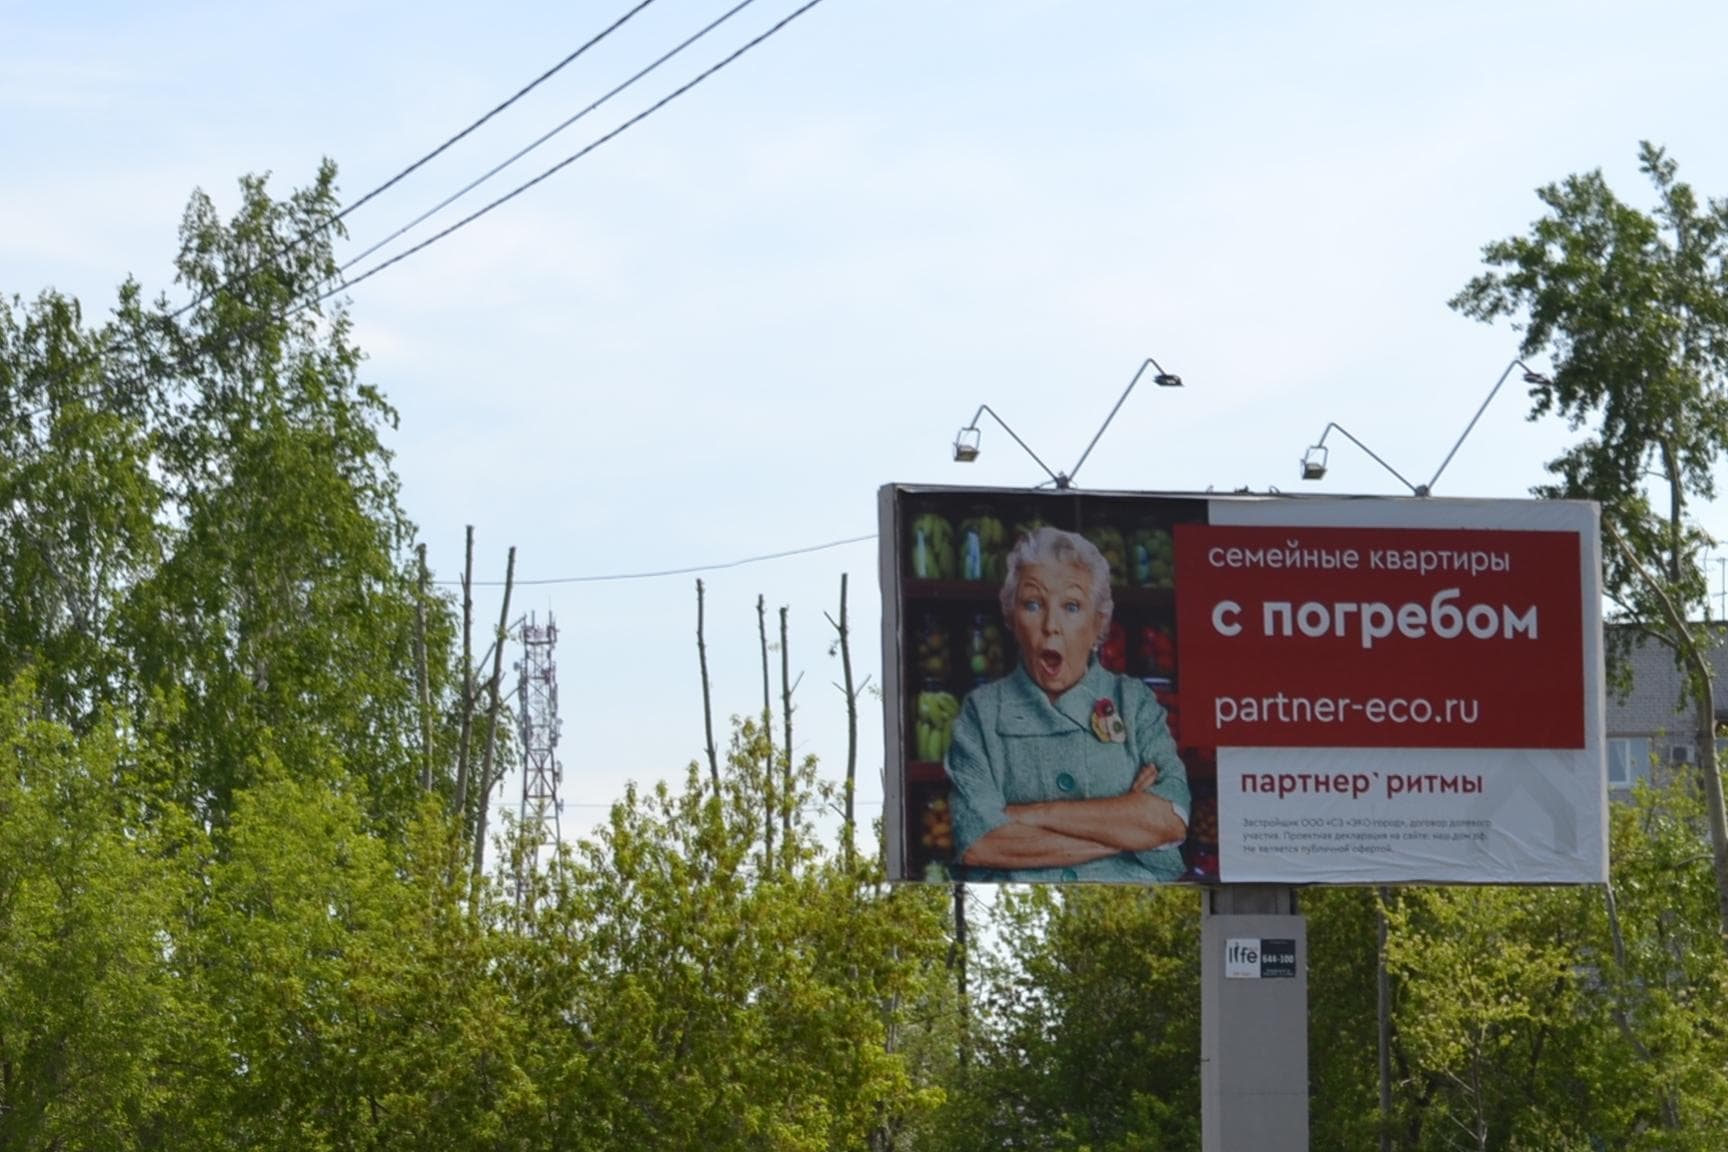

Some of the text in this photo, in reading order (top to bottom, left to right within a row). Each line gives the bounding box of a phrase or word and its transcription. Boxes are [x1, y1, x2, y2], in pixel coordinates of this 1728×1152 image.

[1208, 539, 1511, 577] семейные квартиры
[1211, 587, 1539, 649] с погребом
[1214, 691, 1479, 730] partner-eco.ru
[1386, 774, 1484, 799] ритмы
